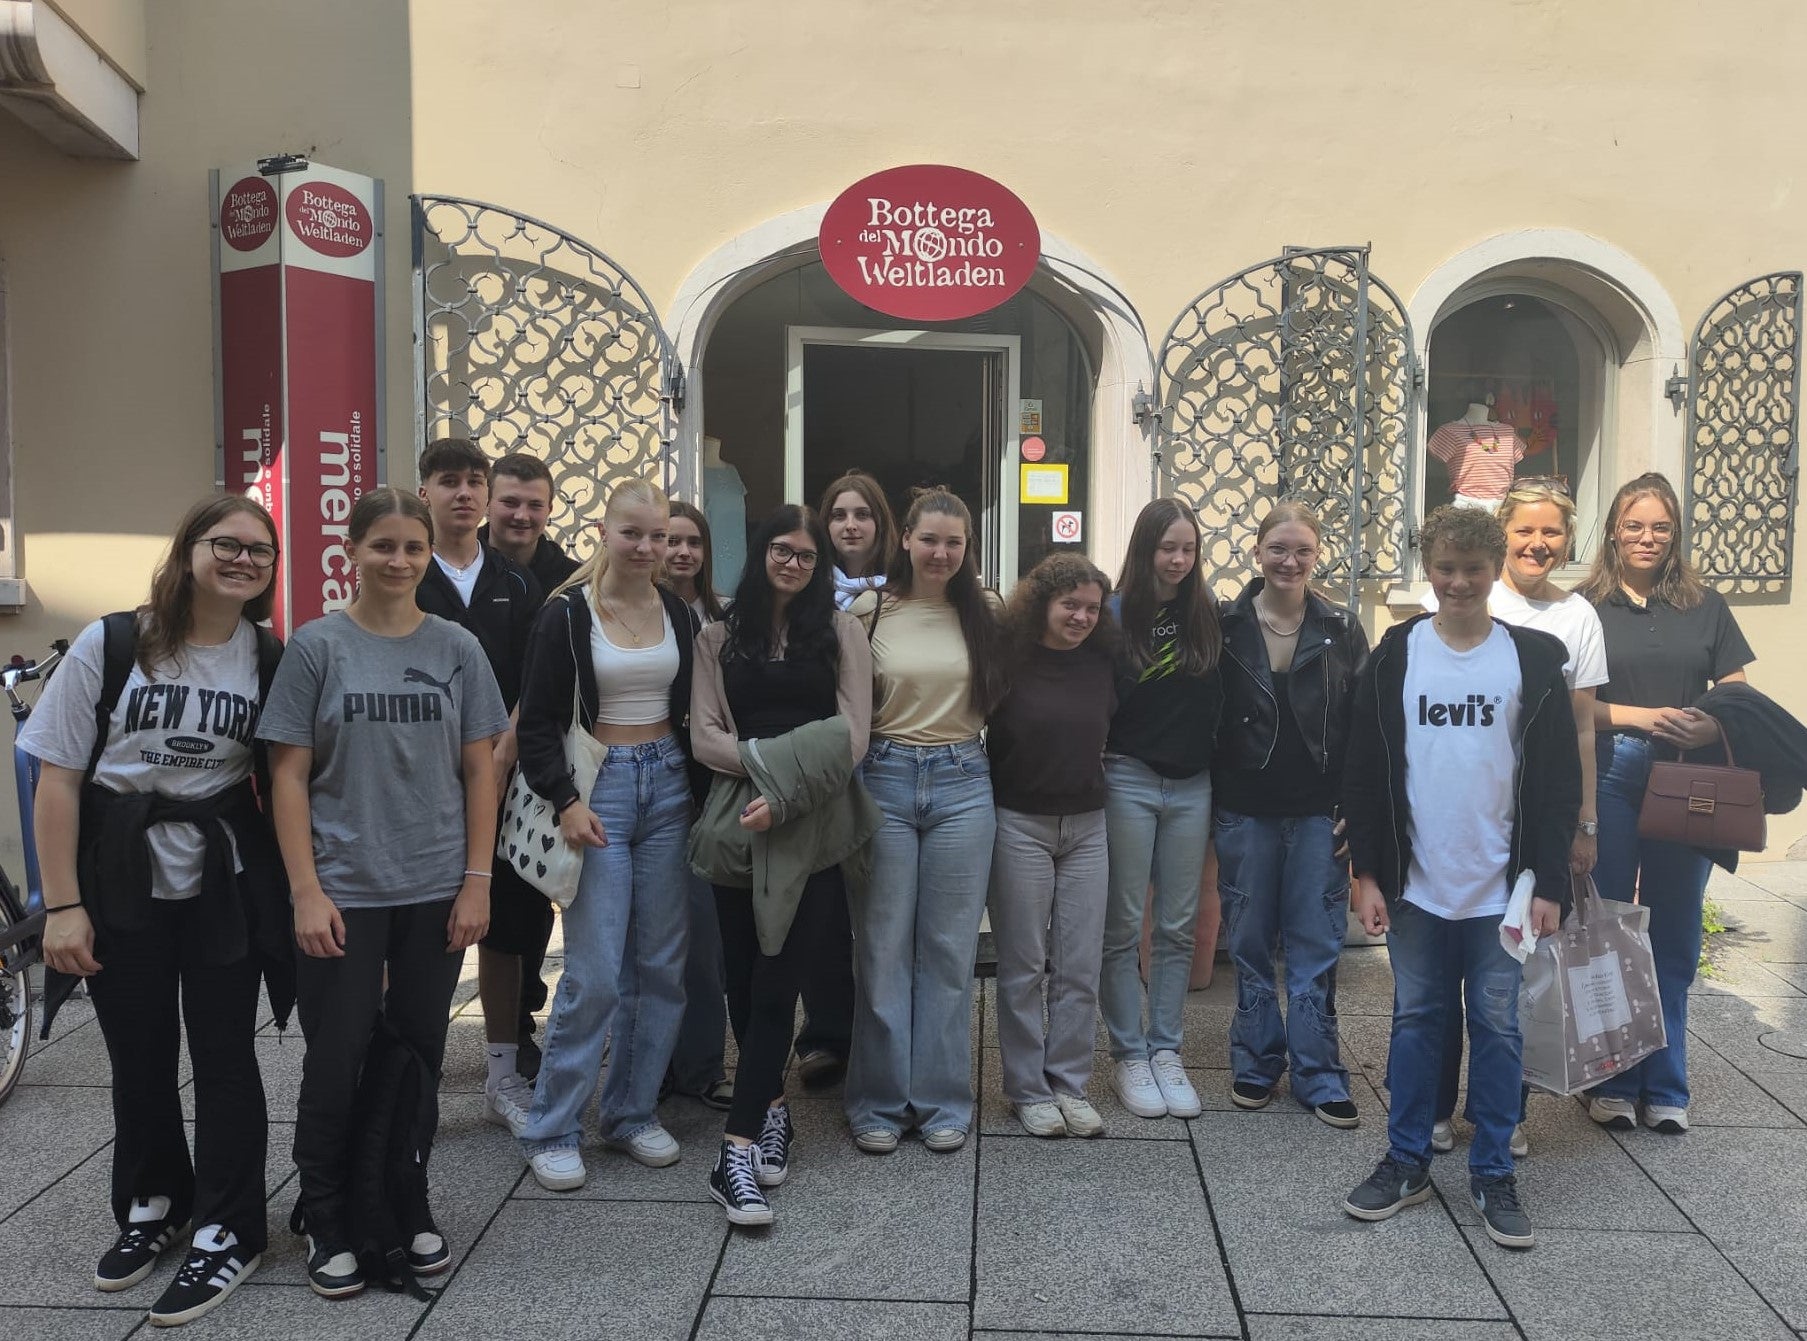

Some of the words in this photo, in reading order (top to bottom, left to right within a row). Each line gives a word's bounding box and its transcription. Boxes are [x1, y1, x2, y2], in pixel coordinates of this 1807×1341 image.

[302, 190, 357, 217] Bottega
[867, 198, 994, 234] Bottega
[297, 220, 363, 248] Weltladen
[859, 230, 881, 242] del
[857, 256, 1005, 286] Weltladen
[350, 411, 361, 471] solidale
[353, 475, 362, 483] e
[320, 431, 353, 615] merca
[125, 684, 190, 734] NEW
[343, 693, 442, 722] PUMA
[171, 739, 210, 751] BROOKLYN
[140, 750, 160, 765] THE
[161, 753, 205, 769] EMPIRE
